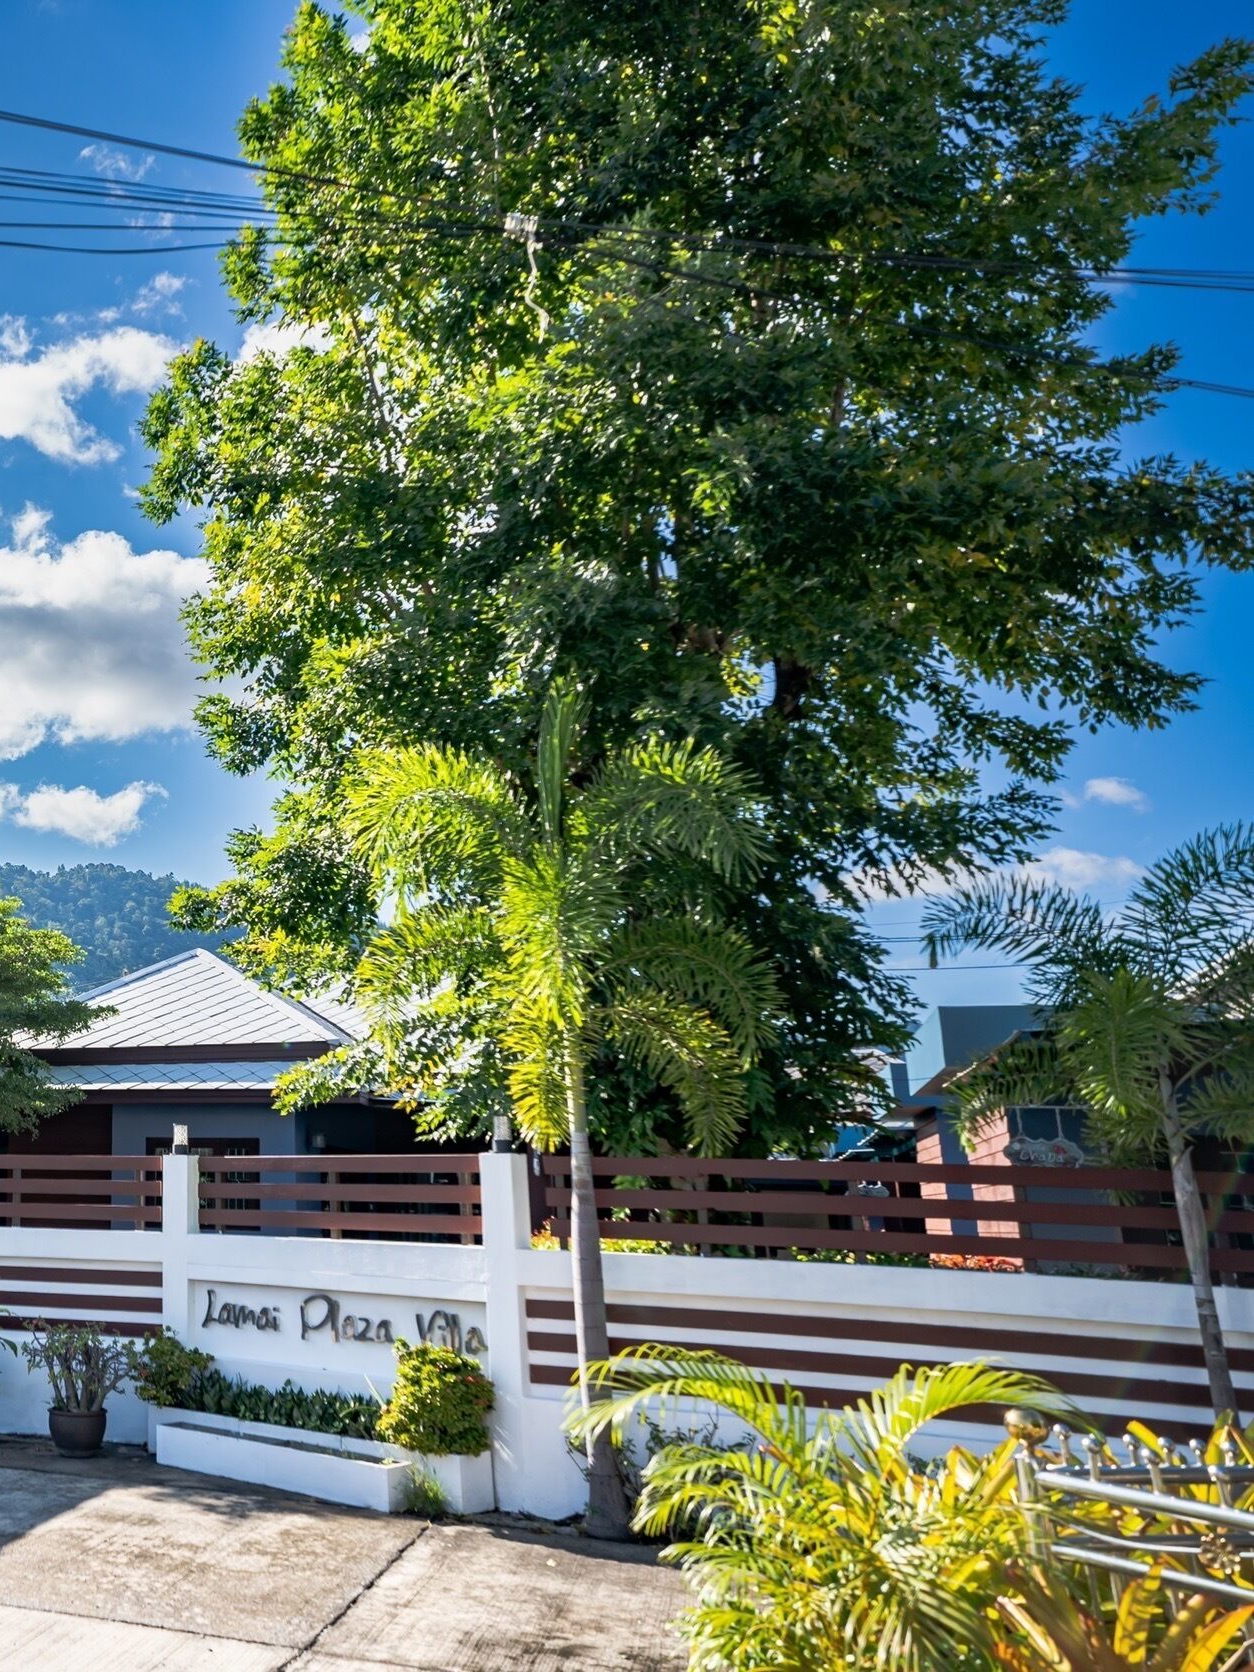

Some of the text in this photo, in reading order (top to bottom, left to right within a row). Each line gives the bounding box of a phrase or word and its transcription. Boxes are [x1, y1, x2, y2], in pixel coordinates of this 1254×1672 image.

[202, 1289, 488, 1357] Lamai Plaza Villa
